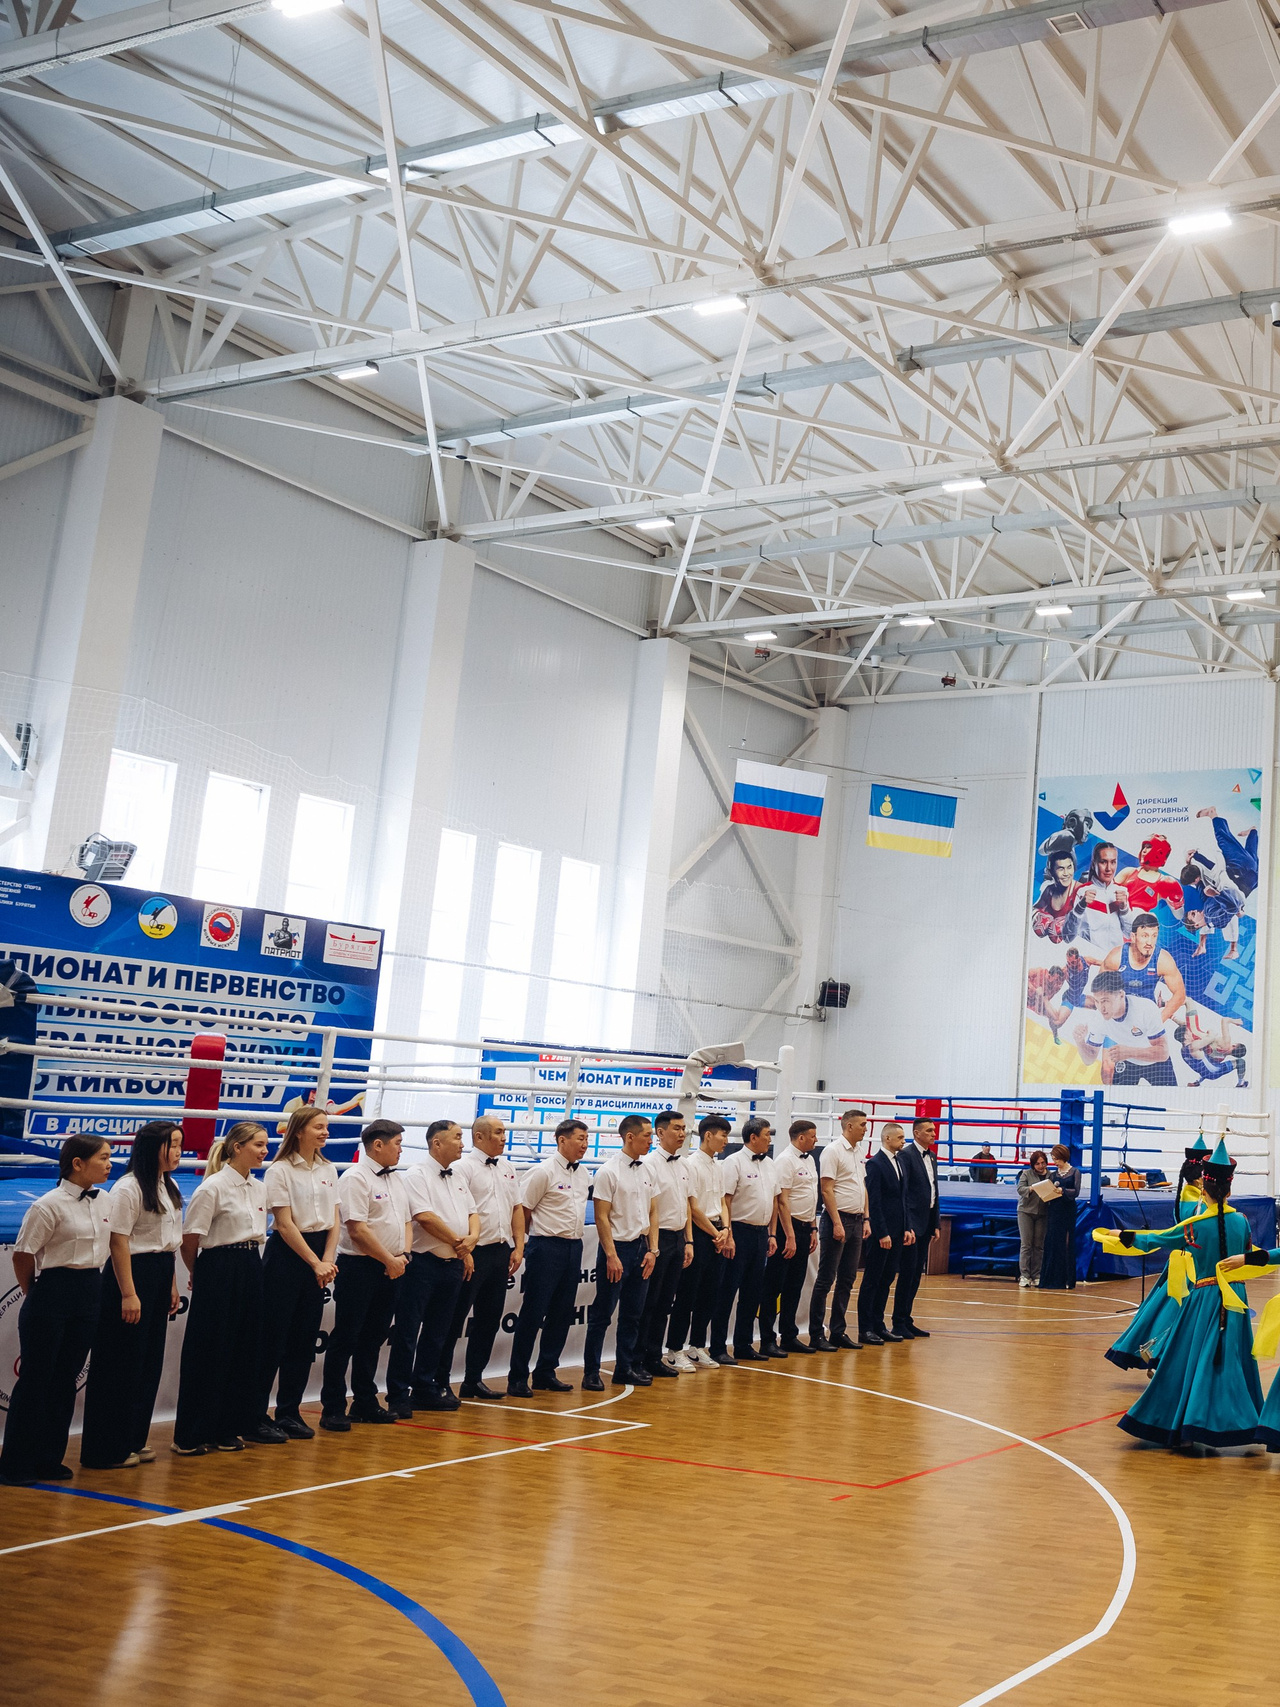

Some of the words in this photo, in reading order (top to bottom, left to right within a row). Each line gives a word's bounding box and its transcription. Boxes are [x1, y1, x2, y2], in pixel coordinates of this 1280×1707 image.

[1136, 797, 1178, 805] ДИРЕКЦИЯ
[1136, 806, 1189, 815] СПОРТИВНЫХ
[1135, 814, 1190, 825] СООРУЖЕНИЙ
[264, 946, 301, 958] ПАТРИОТ
[0, 950, 142, 986] ПИОНАТ
[147, 966, 167, 988] И
[174, 969, 346, 1005] ПЕРВЕНСТВО
[539, 1069, 621, 1086] ЧЕМИОНАТ
[623, 1076, 632, 1086] И
[499, 1094, 513, 1102] ПО
[595, 1100, 664, 1110] ДИСЦИПЛИНАХ
[46, 1117, 59, 1131] В
